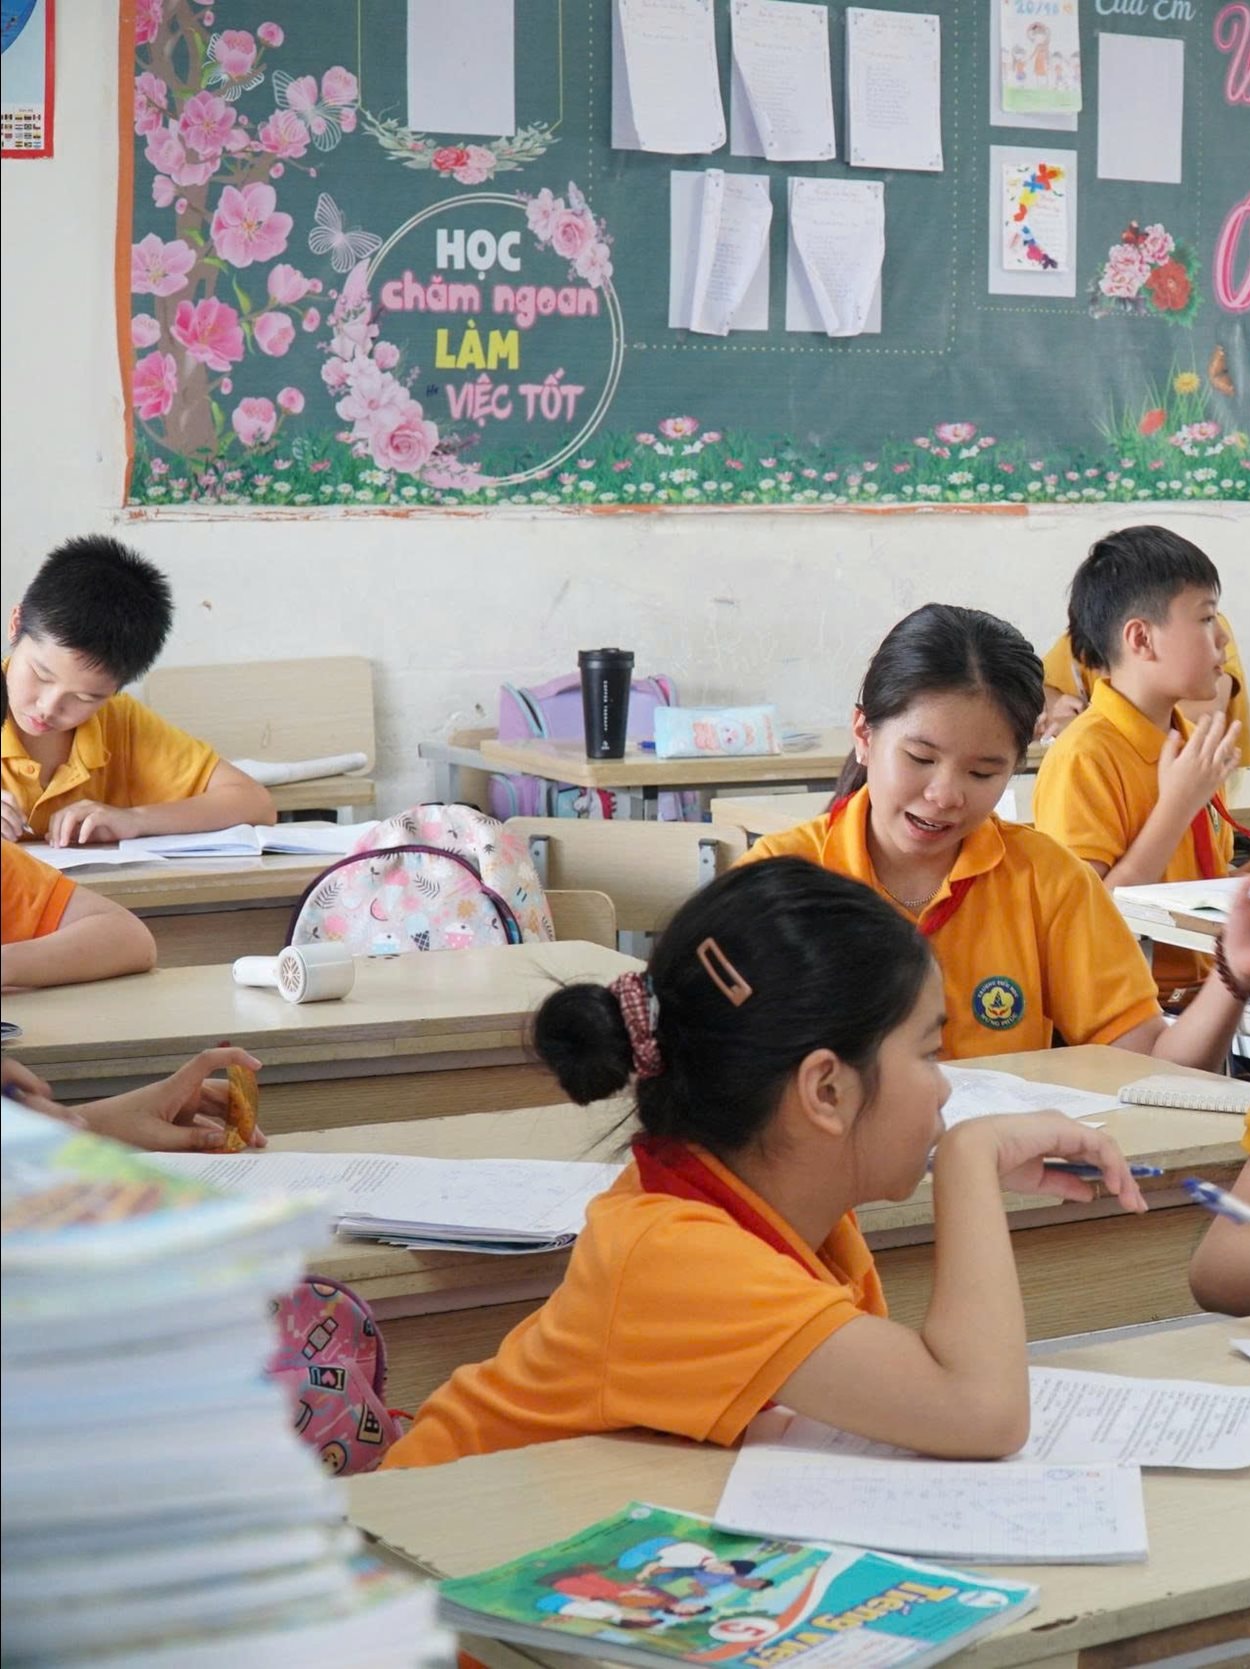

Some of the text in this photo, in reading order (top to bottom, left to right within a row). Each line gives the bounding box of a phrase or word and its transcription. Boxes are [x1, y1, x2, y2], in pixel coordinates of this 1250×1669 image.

[1153, 0, 1197, 21] Em
[436, 228, 521, 281] HỌC
[381, 270, 599, 329] chăm ngoan
[435, 318, 520, 370] LÀM
[445, 367, 585, 427] VIỆC TỐT
[718, 1621, 766, 1639] 5
[811, 1580, 959, 1631] Tiếng
